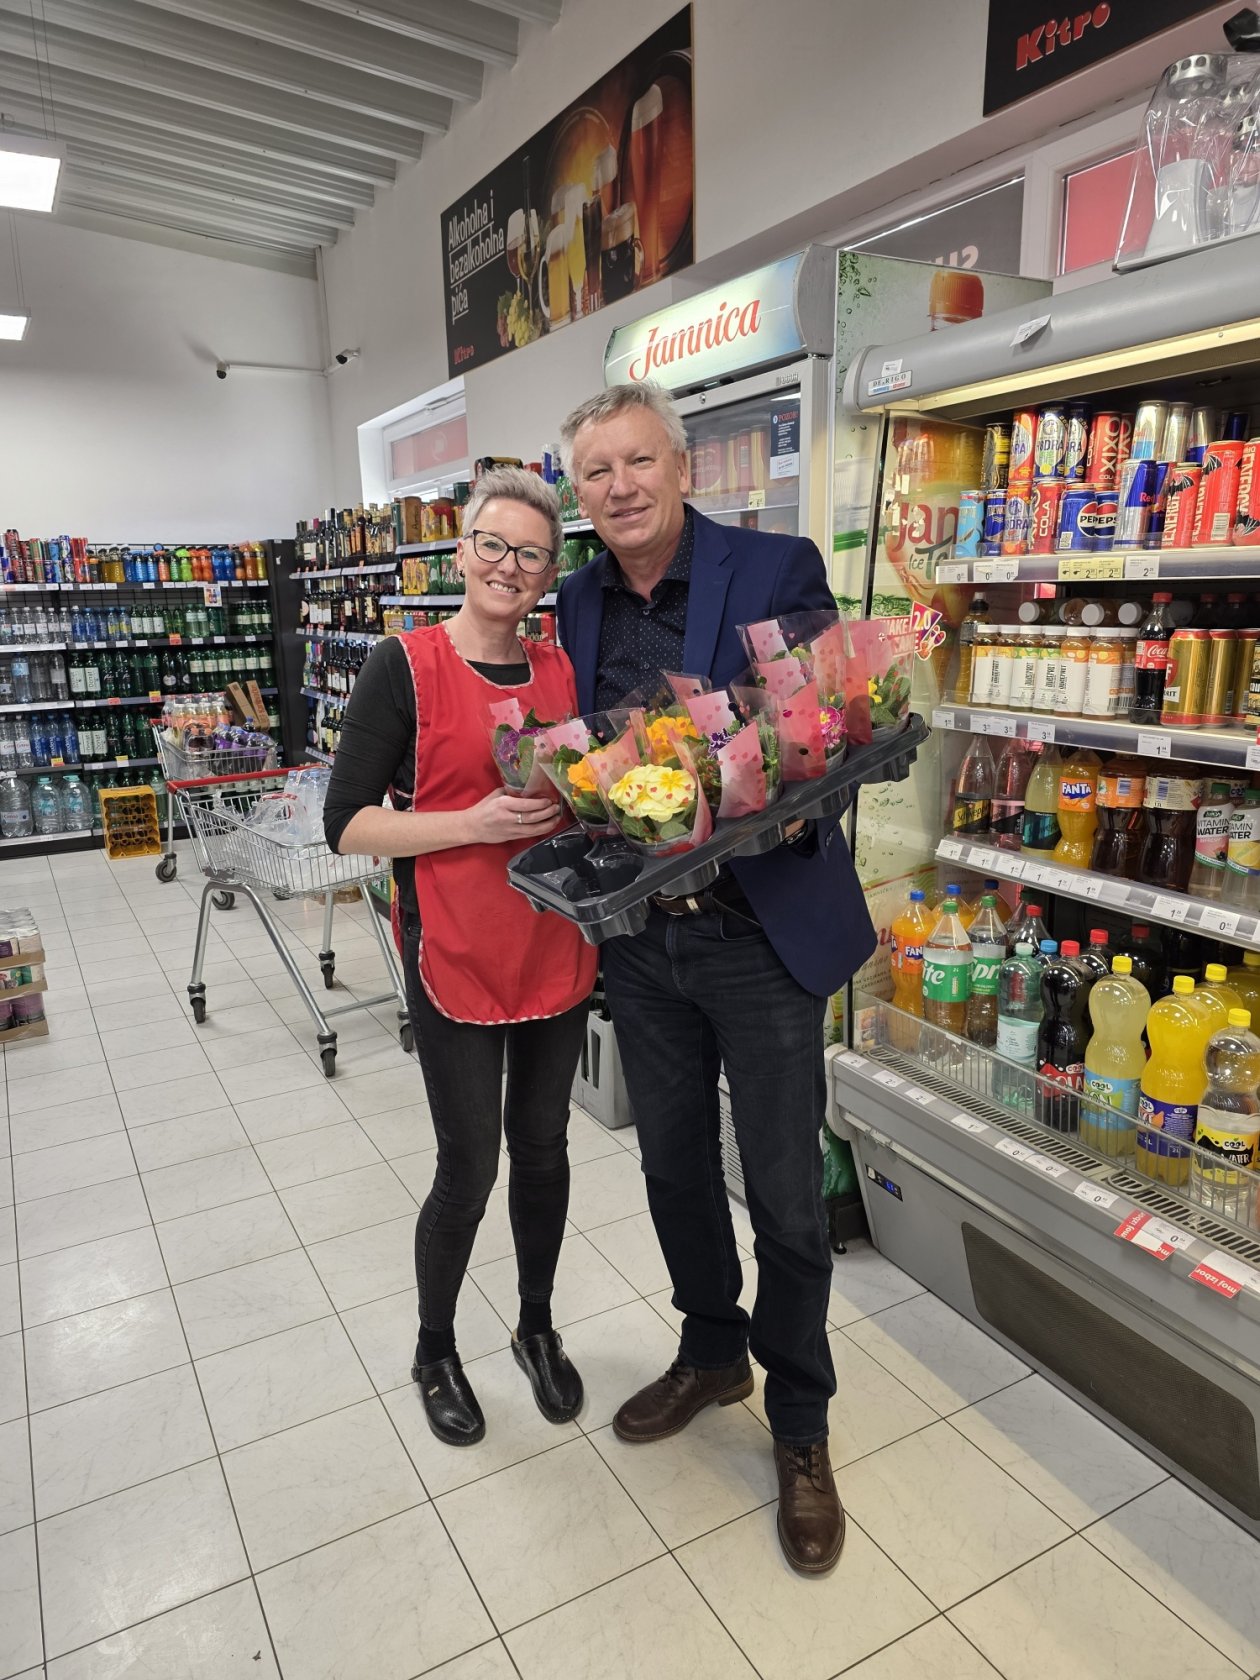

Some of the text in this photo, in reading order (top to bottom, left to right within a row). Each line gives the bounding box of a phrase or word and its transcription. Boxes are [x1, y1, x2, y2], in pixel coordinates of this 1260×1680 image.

[1016, 3, 1112, 71] Kitro
[449, 197, 488, 249] Alkoholna
[450, 228, 505, 284] bezalkoholna
[451, 287, 469, 324] pića
[629, 299, 762, 382] Jamnica
[1100, 416, 1121, 473] XIXO
[892, 502, 960, 552] Jan
[1039, 501, 1051, 537] COLA
[908, 554, 925, 570] Ice
[1061, 782, 1092, 795] FANTA
[905, 946, 923, 957] FAN
[1224, 1141, 1246, 1149] COOL
[1121, 1211, 1145, 1239] moj izbor
[1195, 1268, 1237, 1294] moj izbor
